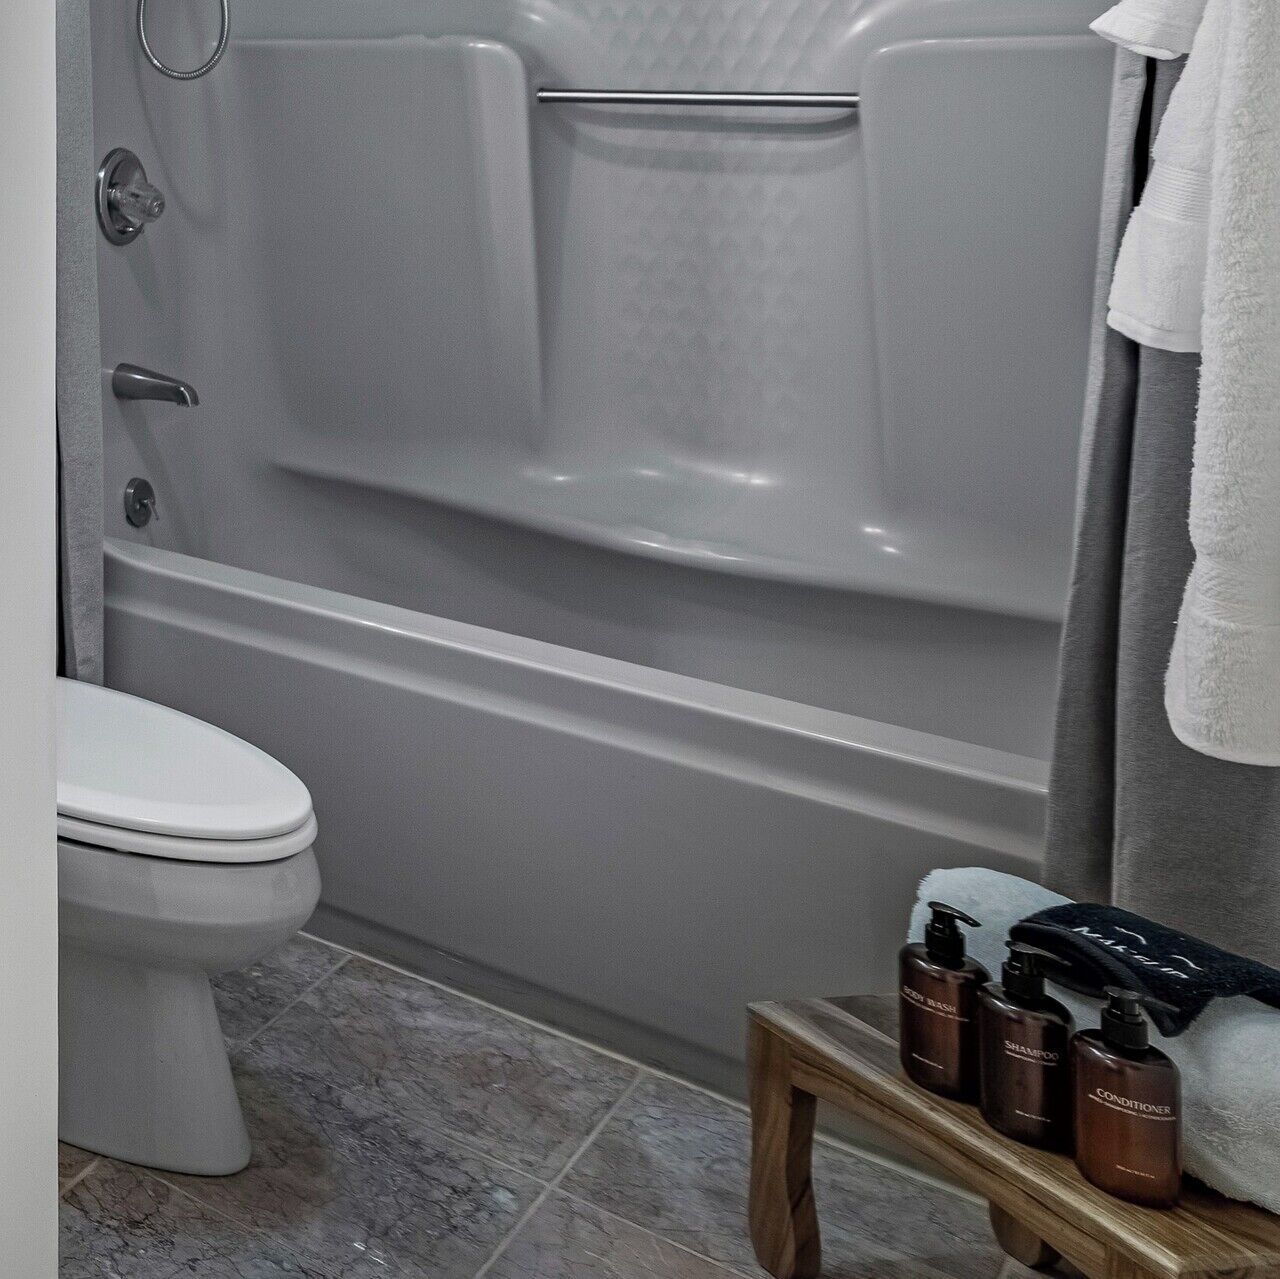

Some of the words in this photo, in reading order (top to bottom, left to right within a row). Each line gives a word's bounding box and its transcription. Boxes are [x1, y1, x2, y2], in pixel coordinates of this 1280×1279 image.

[903, 984, 924, 1002] BODY
[926, 997, 957, 1014] WASH
[1004, 1040, 1059, 1061] SHAMPOO
[1096, 1088, 1171, 1115] CONDITIONER
